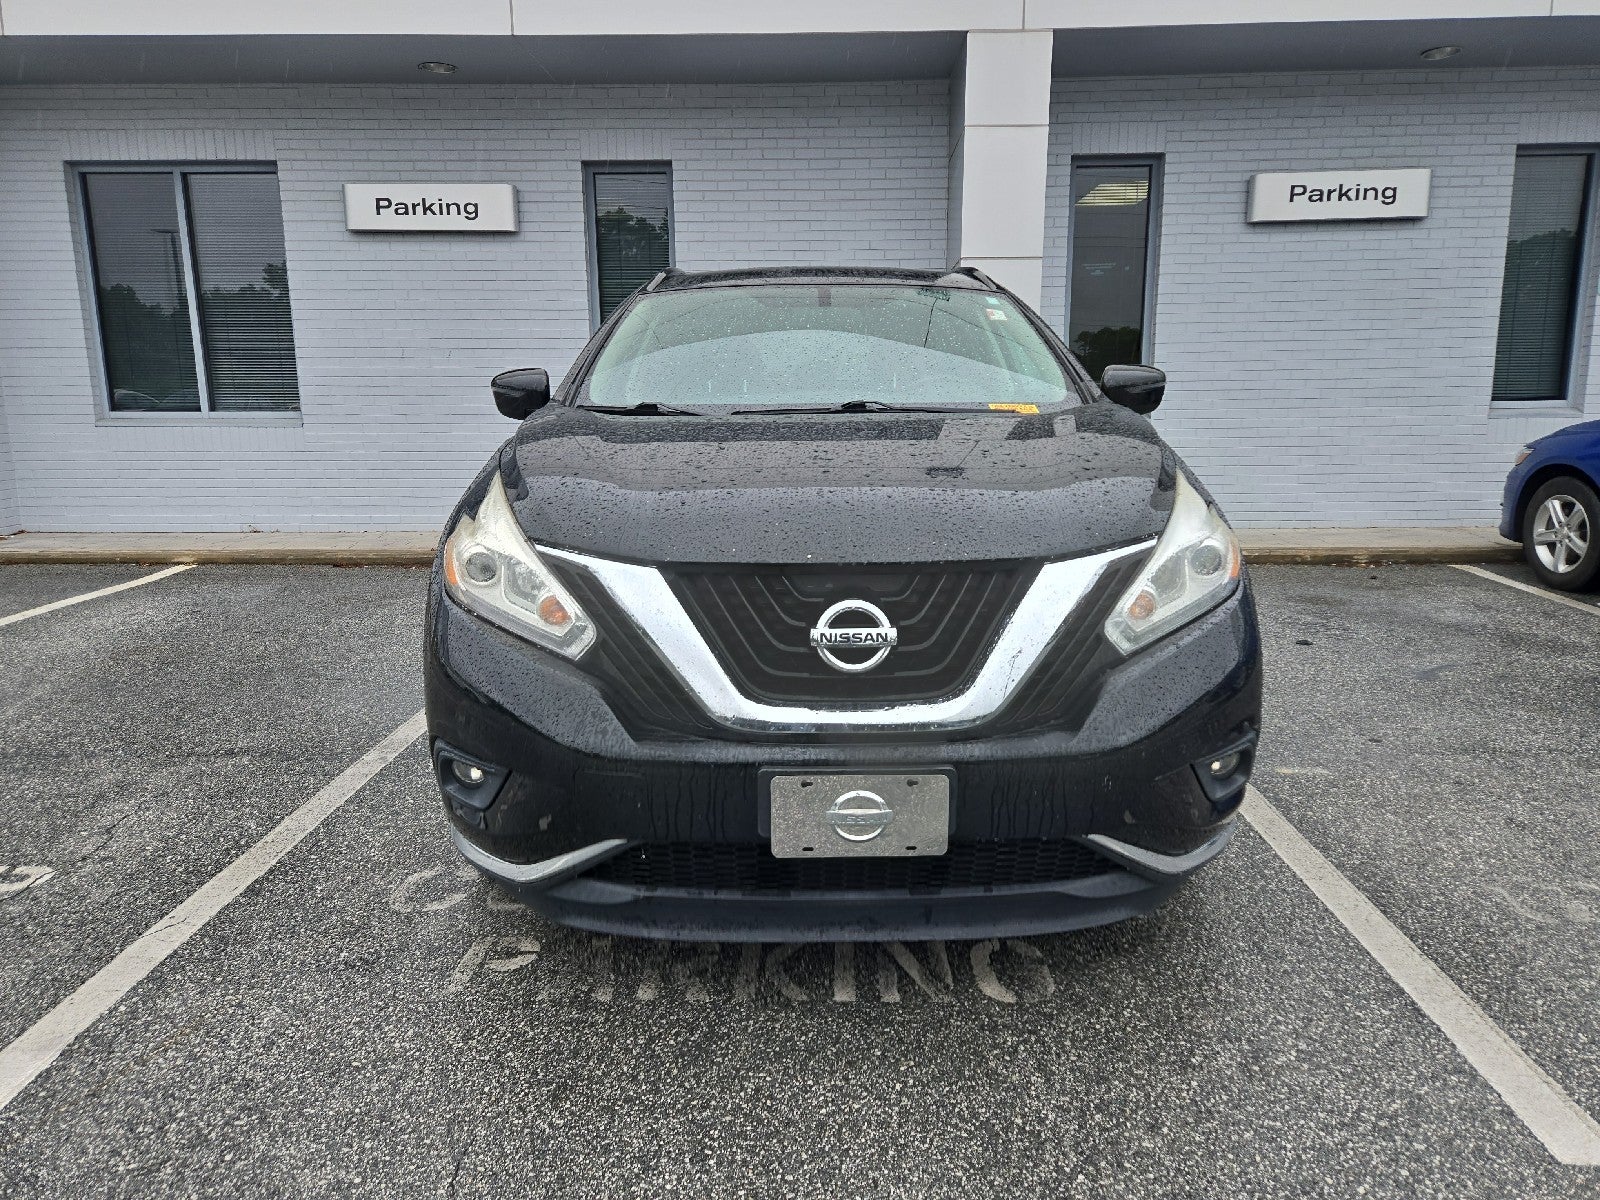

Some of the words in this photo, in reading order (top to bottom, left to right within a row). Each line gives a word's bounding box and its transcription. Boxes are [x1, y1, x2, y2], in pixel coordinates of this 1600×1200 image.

[1288, 183, 1398, 206] Parking
[375, 197, 480, 221] Parking
[819, 632, 888, 644] NISSAN
[446, 934, 1055, 1003] PKING
